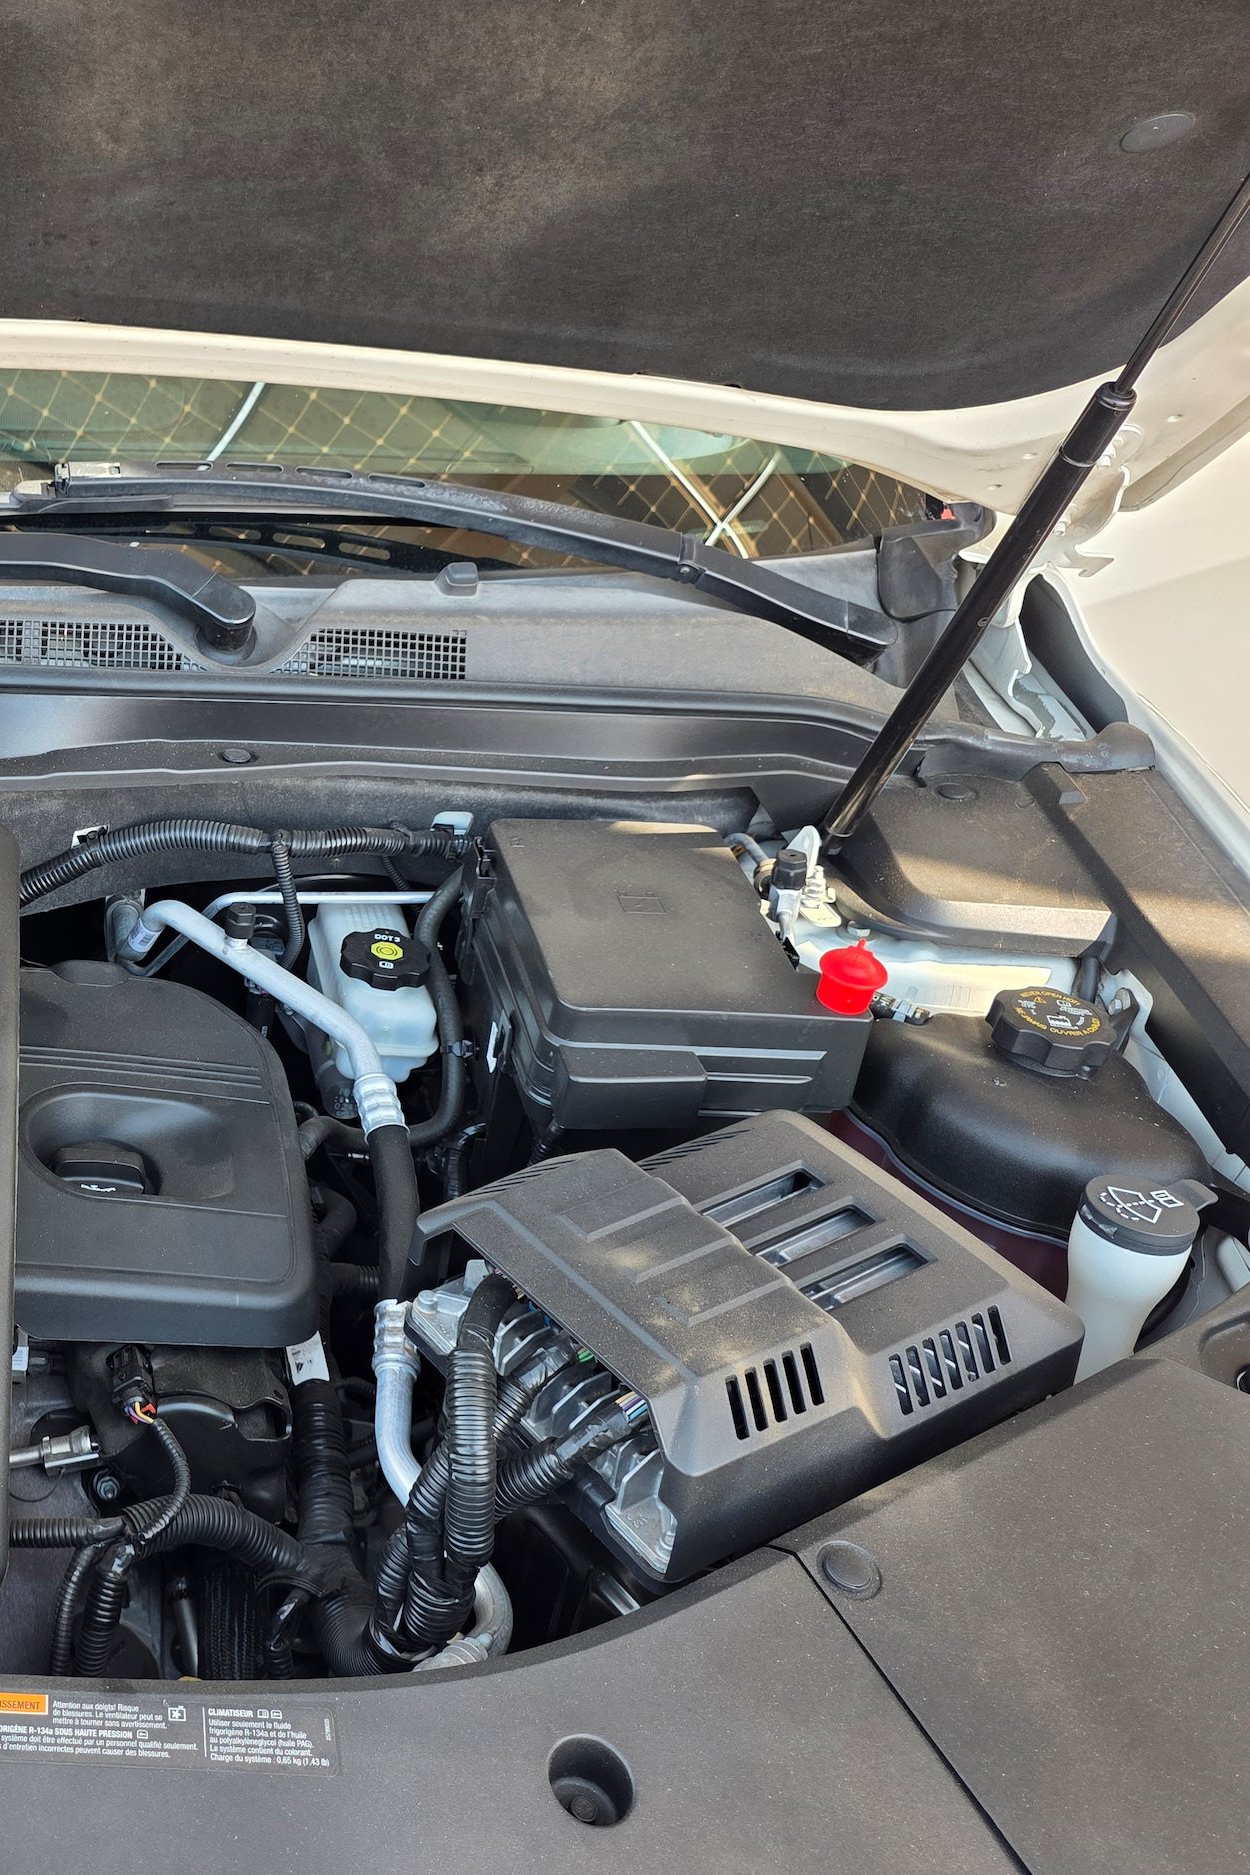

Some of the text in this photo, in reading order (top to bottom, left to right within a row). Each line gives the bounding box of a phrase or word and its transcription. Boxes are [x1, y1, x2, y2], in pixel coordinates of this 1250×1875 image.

[1050, 1028, 1084, 1036] OUVRIR
[53, 1701, 80, 1709] Attention
[95, 1702, 116, 1710] doigts!
[118, 1703, 139, 1713] Risque
[63, 1710, 94, 1718] blessures.
[105, 1711, 138, 1720] ventilateur
[208, 1709, 253, 1717] CLIMATISEUR
[81, 1719, 103, 1727] tourner
[121, 1721, 167, 1729] avertissement.
[209, 1719, 230, 1727] Utiliser
[29, 1726, 53, 1735] R-134a
[55, 1728, 73, 1736] SOUS
[75, 1729, 96, 1737] HAUTE
[98, 1730, 132, 1739] PRESSION
[209, 1728, 243, 1736] frigorigène
[244, 1729, 268, 1737] R-134a
[1, 1734, 27, 1743] système
[29, 1735, 41, 1743] doit
[43, 1735, 55, 1743] être
[57, 1736, 83, 1745] effectué
[106, 1738, 137, 1748] personnel
[138, 1740, 161, 1749] qualifié
[163, 1741, 198, 1749] seulement.
[278, 1739, 295, 1747] (huile
[3, 1742, 37, 1751] d'entretien
[38, 1744, 73, 1753] incorrectes
[75, 1746, 100, 1755] peuvent
[102, 1747, 124, 1755] causer
[138, 1749, 170, 1758] blessures.
[220, 1746, 245, 1754] système
[248, 1746, 273, 1754] contient
[211, 1753, 233, 1762] Charge
[245, 1755, 271, 1763] système
[293, 1757, 301, 1765] kg
[321, 1759, 329, 1767] lb)
